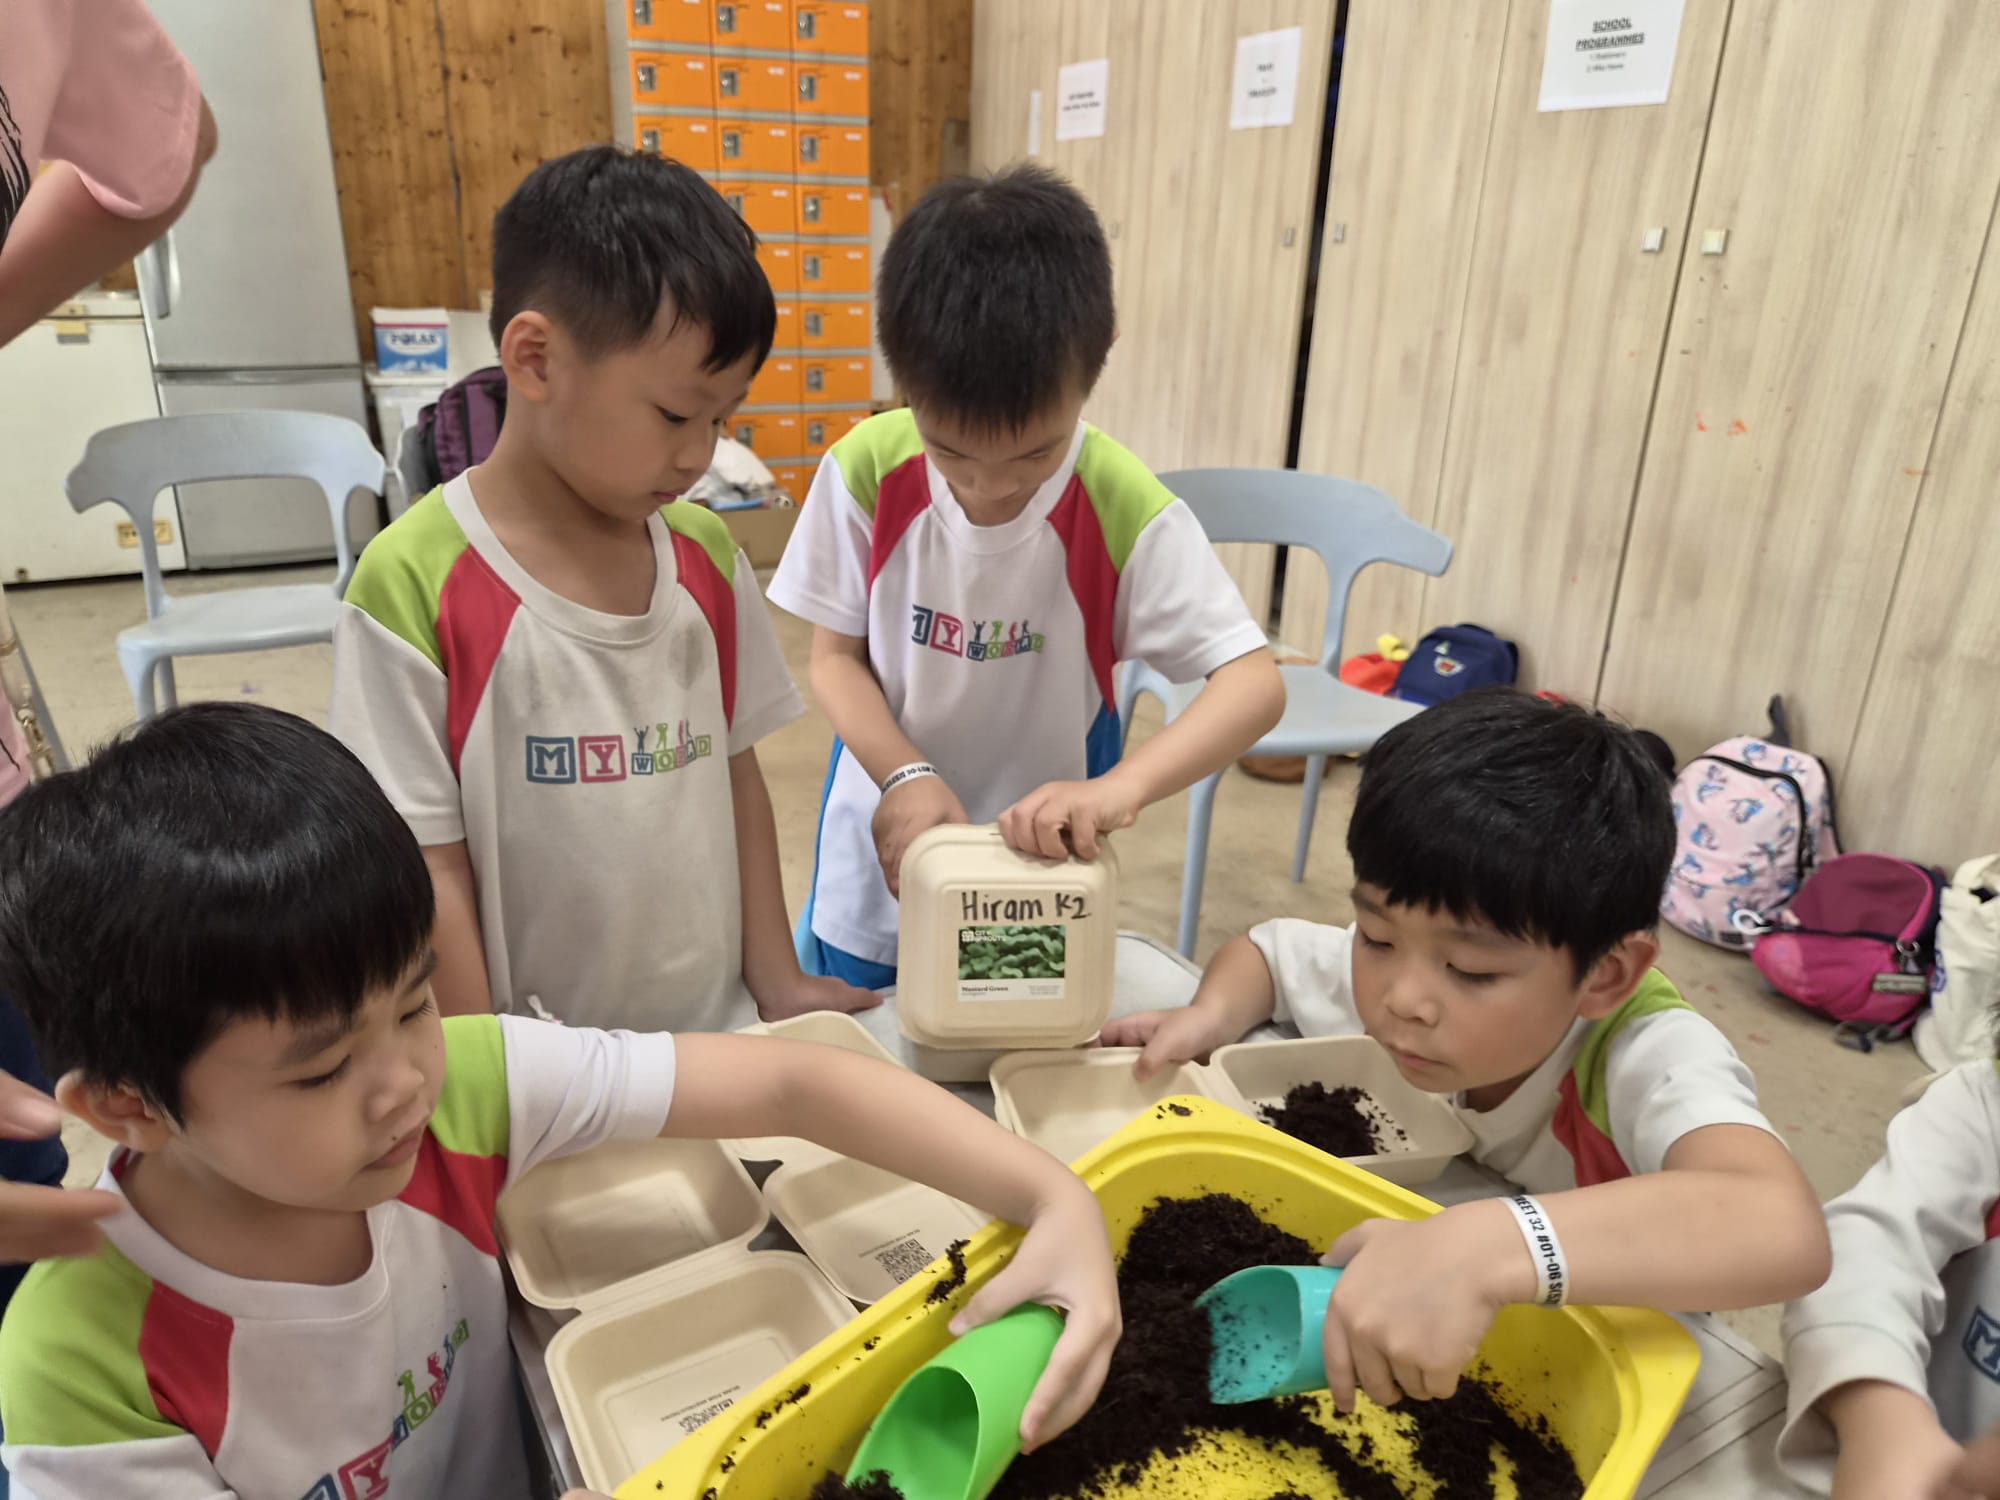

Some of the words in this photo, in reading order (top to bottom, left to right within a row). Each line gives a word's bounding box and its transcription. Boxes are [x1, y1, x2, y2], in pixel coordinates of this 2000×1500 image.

[1592, 17, 1632, 32] SCHOOL
[1575, 32, 1645, 51] PROGRAMMES
[391, 334, 436, 346] POLAR
[528, 737, 625, 782] MY
[962, 891, 1043, 921] Hiram
[1055, 893, 1091, 920] K2
[1528, 1217, 1545, 1232] 32
[1536, 1235, 1562, 1280] #01-06
